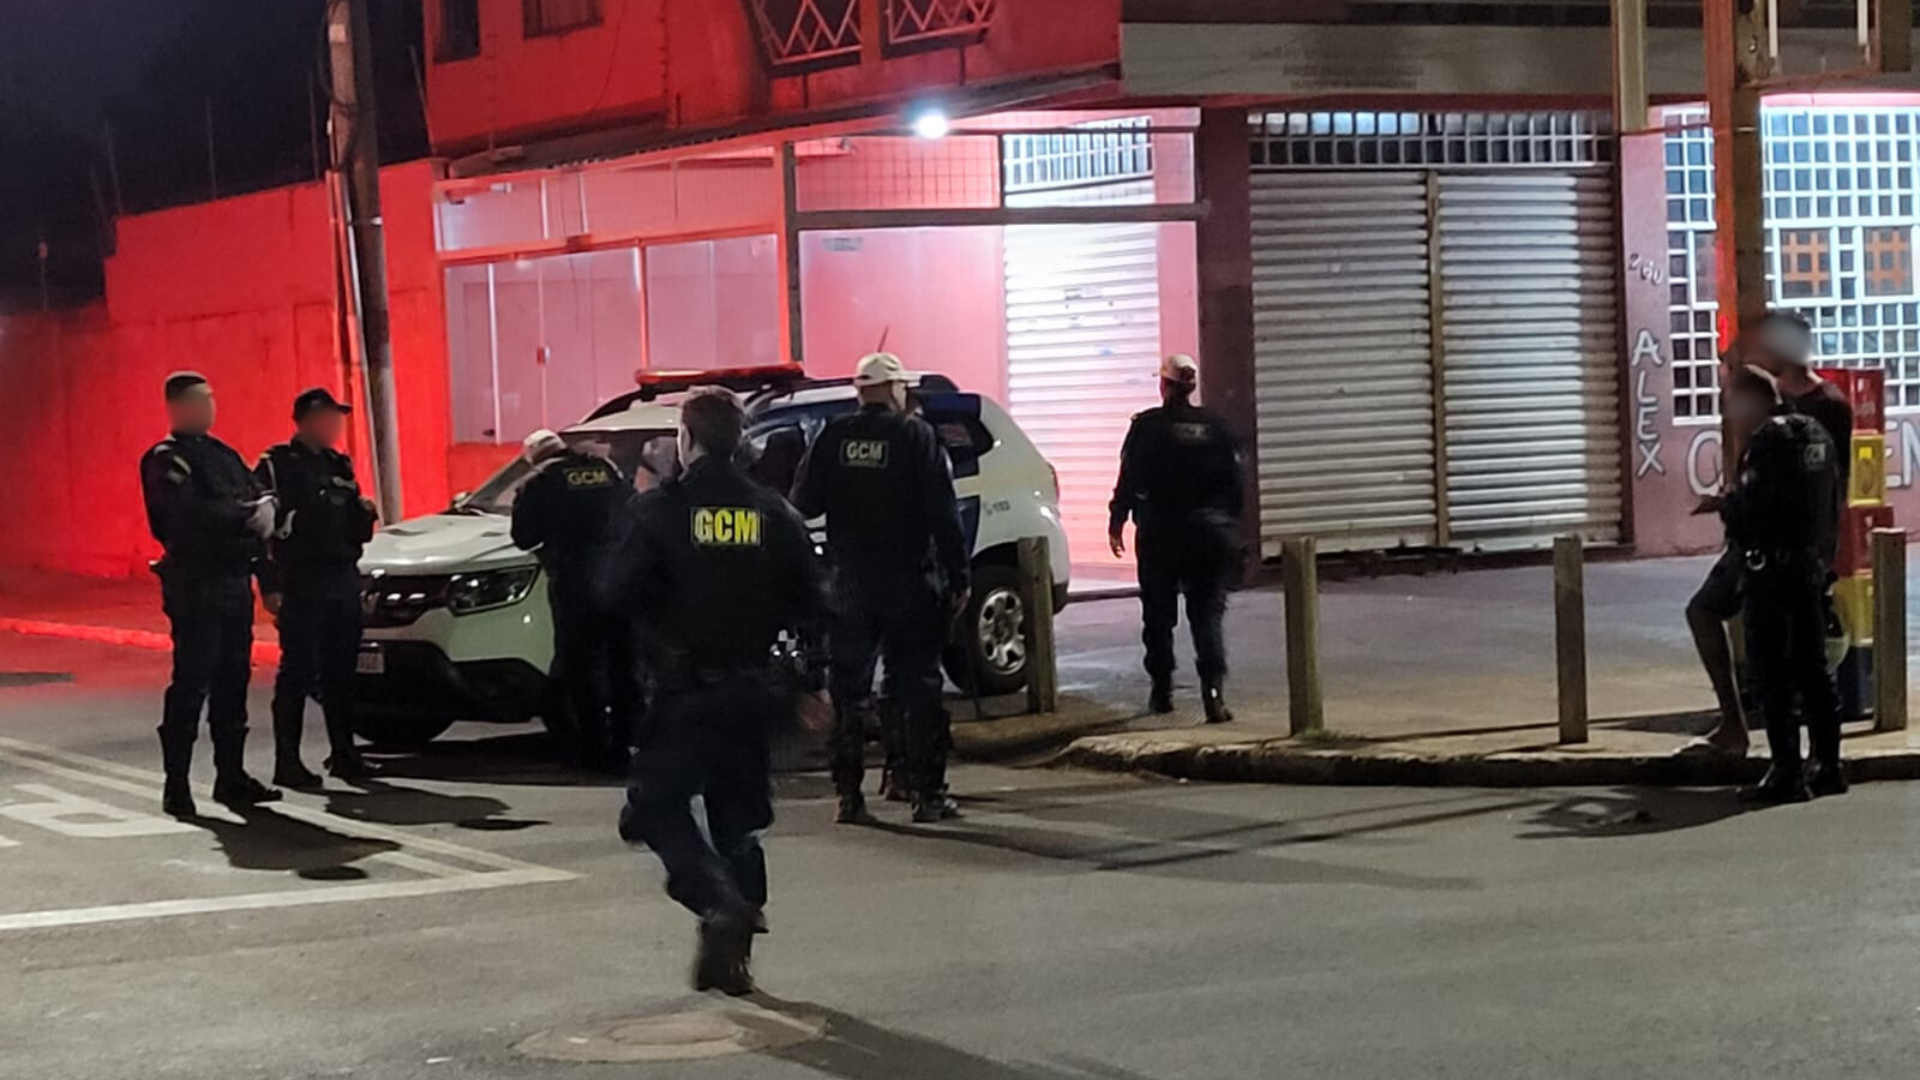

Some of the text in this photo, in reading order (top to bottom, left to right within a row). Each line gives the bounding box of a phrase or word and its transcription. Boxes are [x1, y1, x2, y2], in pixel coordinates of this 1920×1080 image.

[1631, 330, 1665, 478] ALEX
[846, 441, 883, 460] GCM
[567, 470, 608, 485] GCM
[694, 508, 758, 544] GCM
